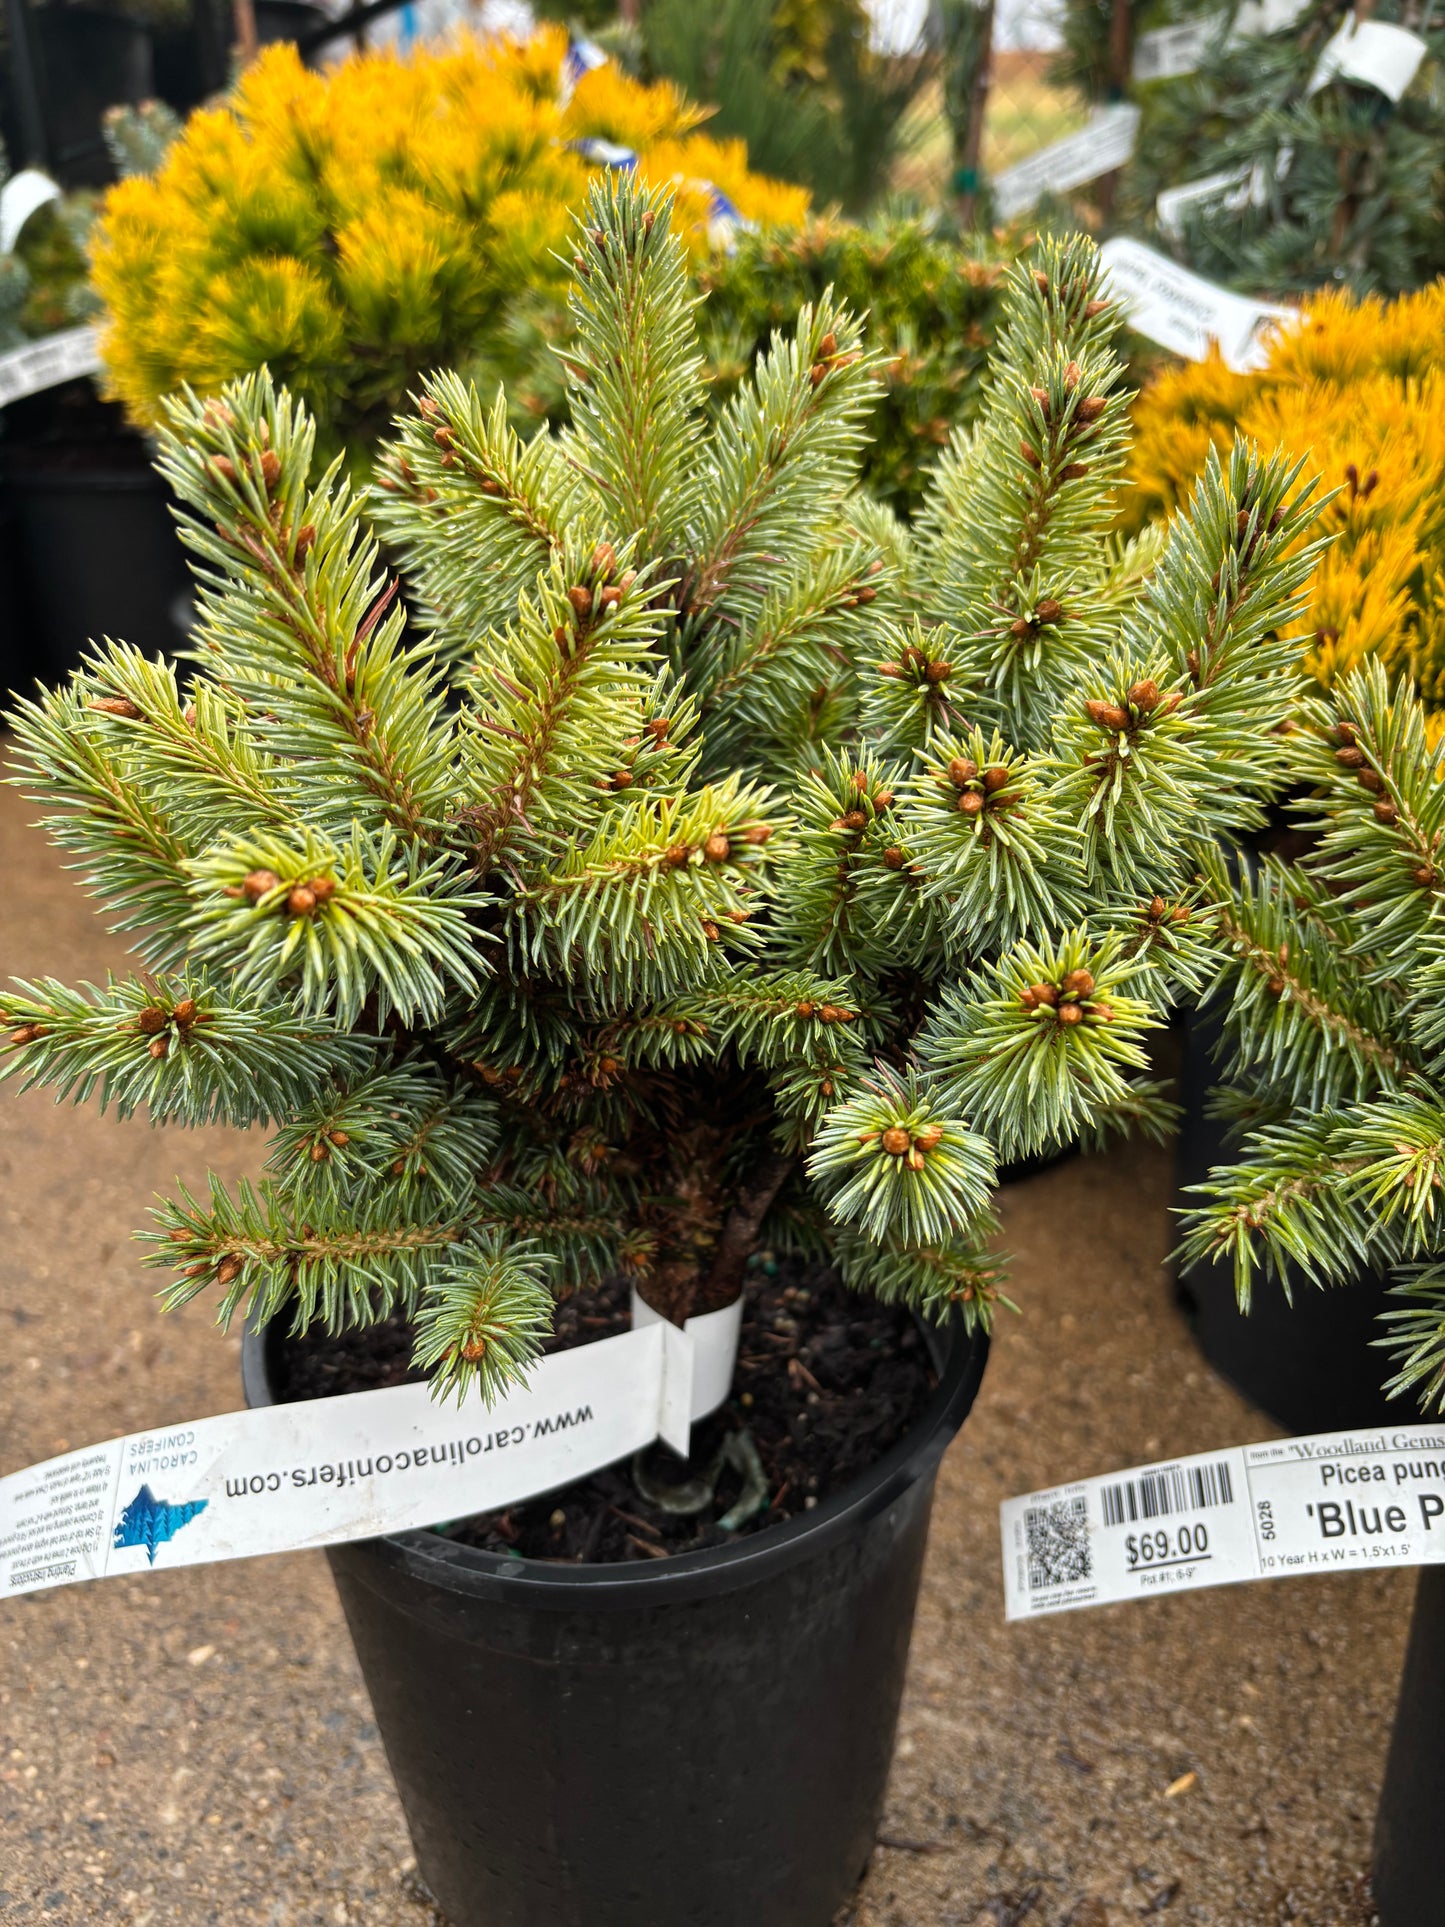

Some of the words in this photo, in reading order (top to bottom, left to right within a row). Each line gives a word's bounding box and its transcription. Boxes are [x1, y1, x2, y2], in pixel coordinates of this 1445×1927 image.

[131, 1431, 195, 1456] CONIFERS
[226, 1405, 593, 1497] www.carolinaconifers.com
[130, 1450, 198, 1476] CAROLINA
[1320, 1463, 1385, 1486] Picea
[1257, 1501, 1276, 1540] 5028
[1306, 1499, 1407, 1538] 'Blue
[1126, 1523, 1208, 1567] $69.00
[1261, 1555, 1275, 1568] 10
[1278, 1554, 1305, 1567] Year
[1308, 1551, 1319, 1563] H
[1319, 1552, 1329, 1562] x
[1329, 1548, 1346, 1561] W
[1362, 1544, 1412, 1559] 1.5'x1.5'
